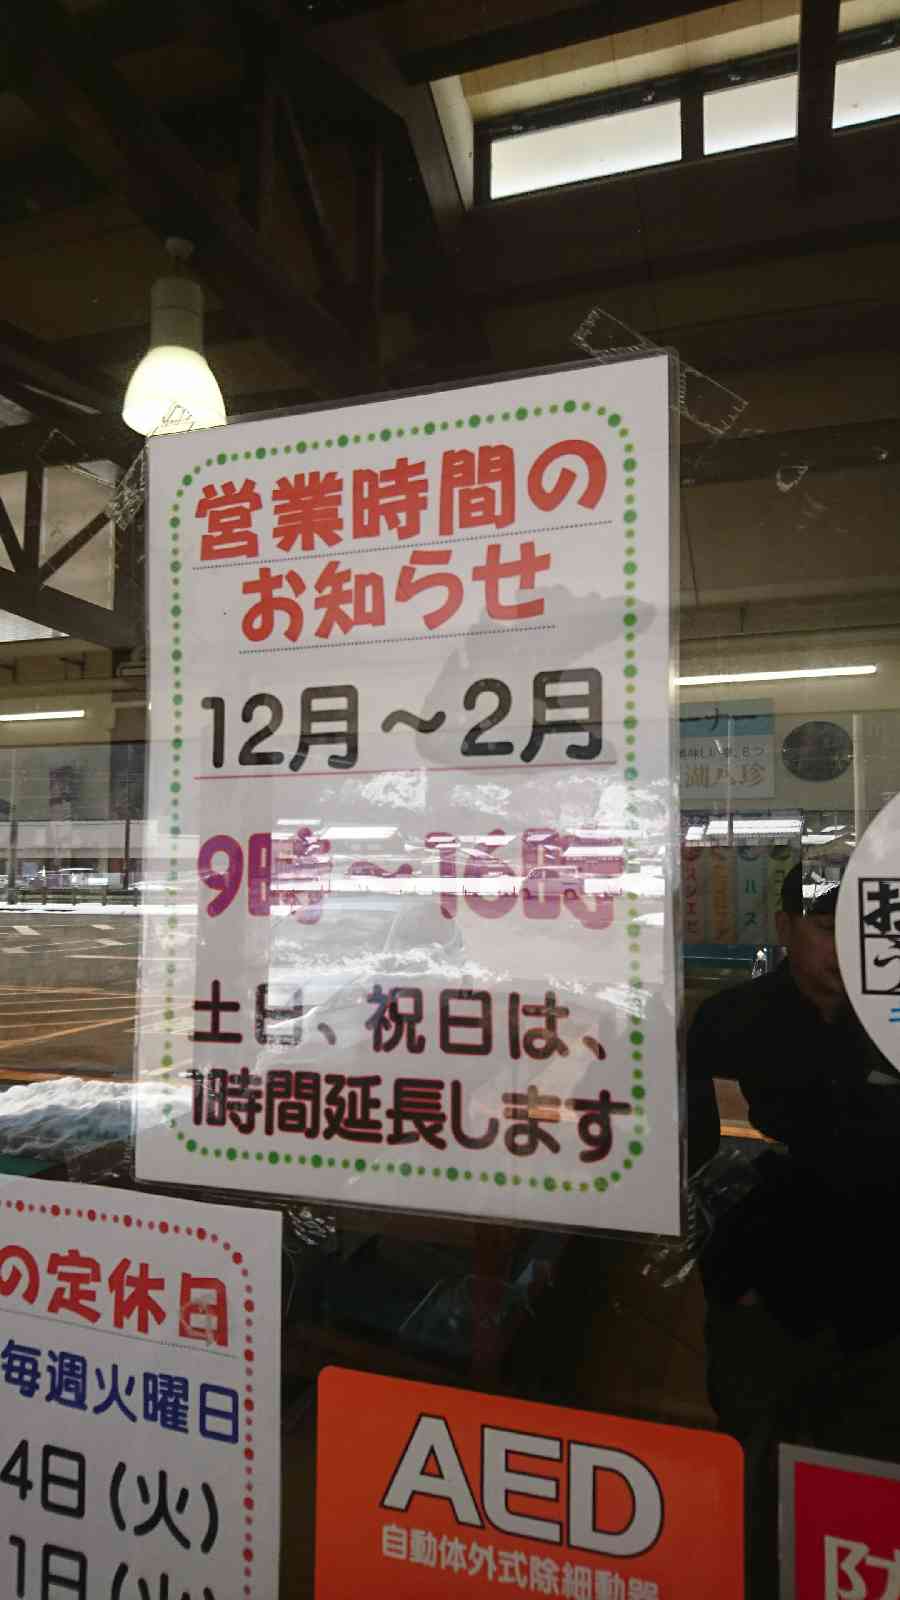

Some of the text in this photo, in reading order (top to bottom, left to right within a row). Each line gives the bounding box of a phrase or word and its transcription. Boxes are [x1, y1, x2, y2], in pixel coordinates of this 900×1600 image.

[195, 439, 607, 561] 営業時間の
[241, 541, 551, 642] お知らせ
[201, 667, 603, 771] 12月～2月
[189, 980, 607, 1060] 土日、祝日は、
[188, 1067, 633, 1164] 1時間延長します
[0, 1244, 229, 1348] の定休日
[0, 1339, 239, 1444] 毎週火曜日
[379, 1412, 664, 1558] AED
[381, 1523, 660, 1600] 自動体外式除細動器
